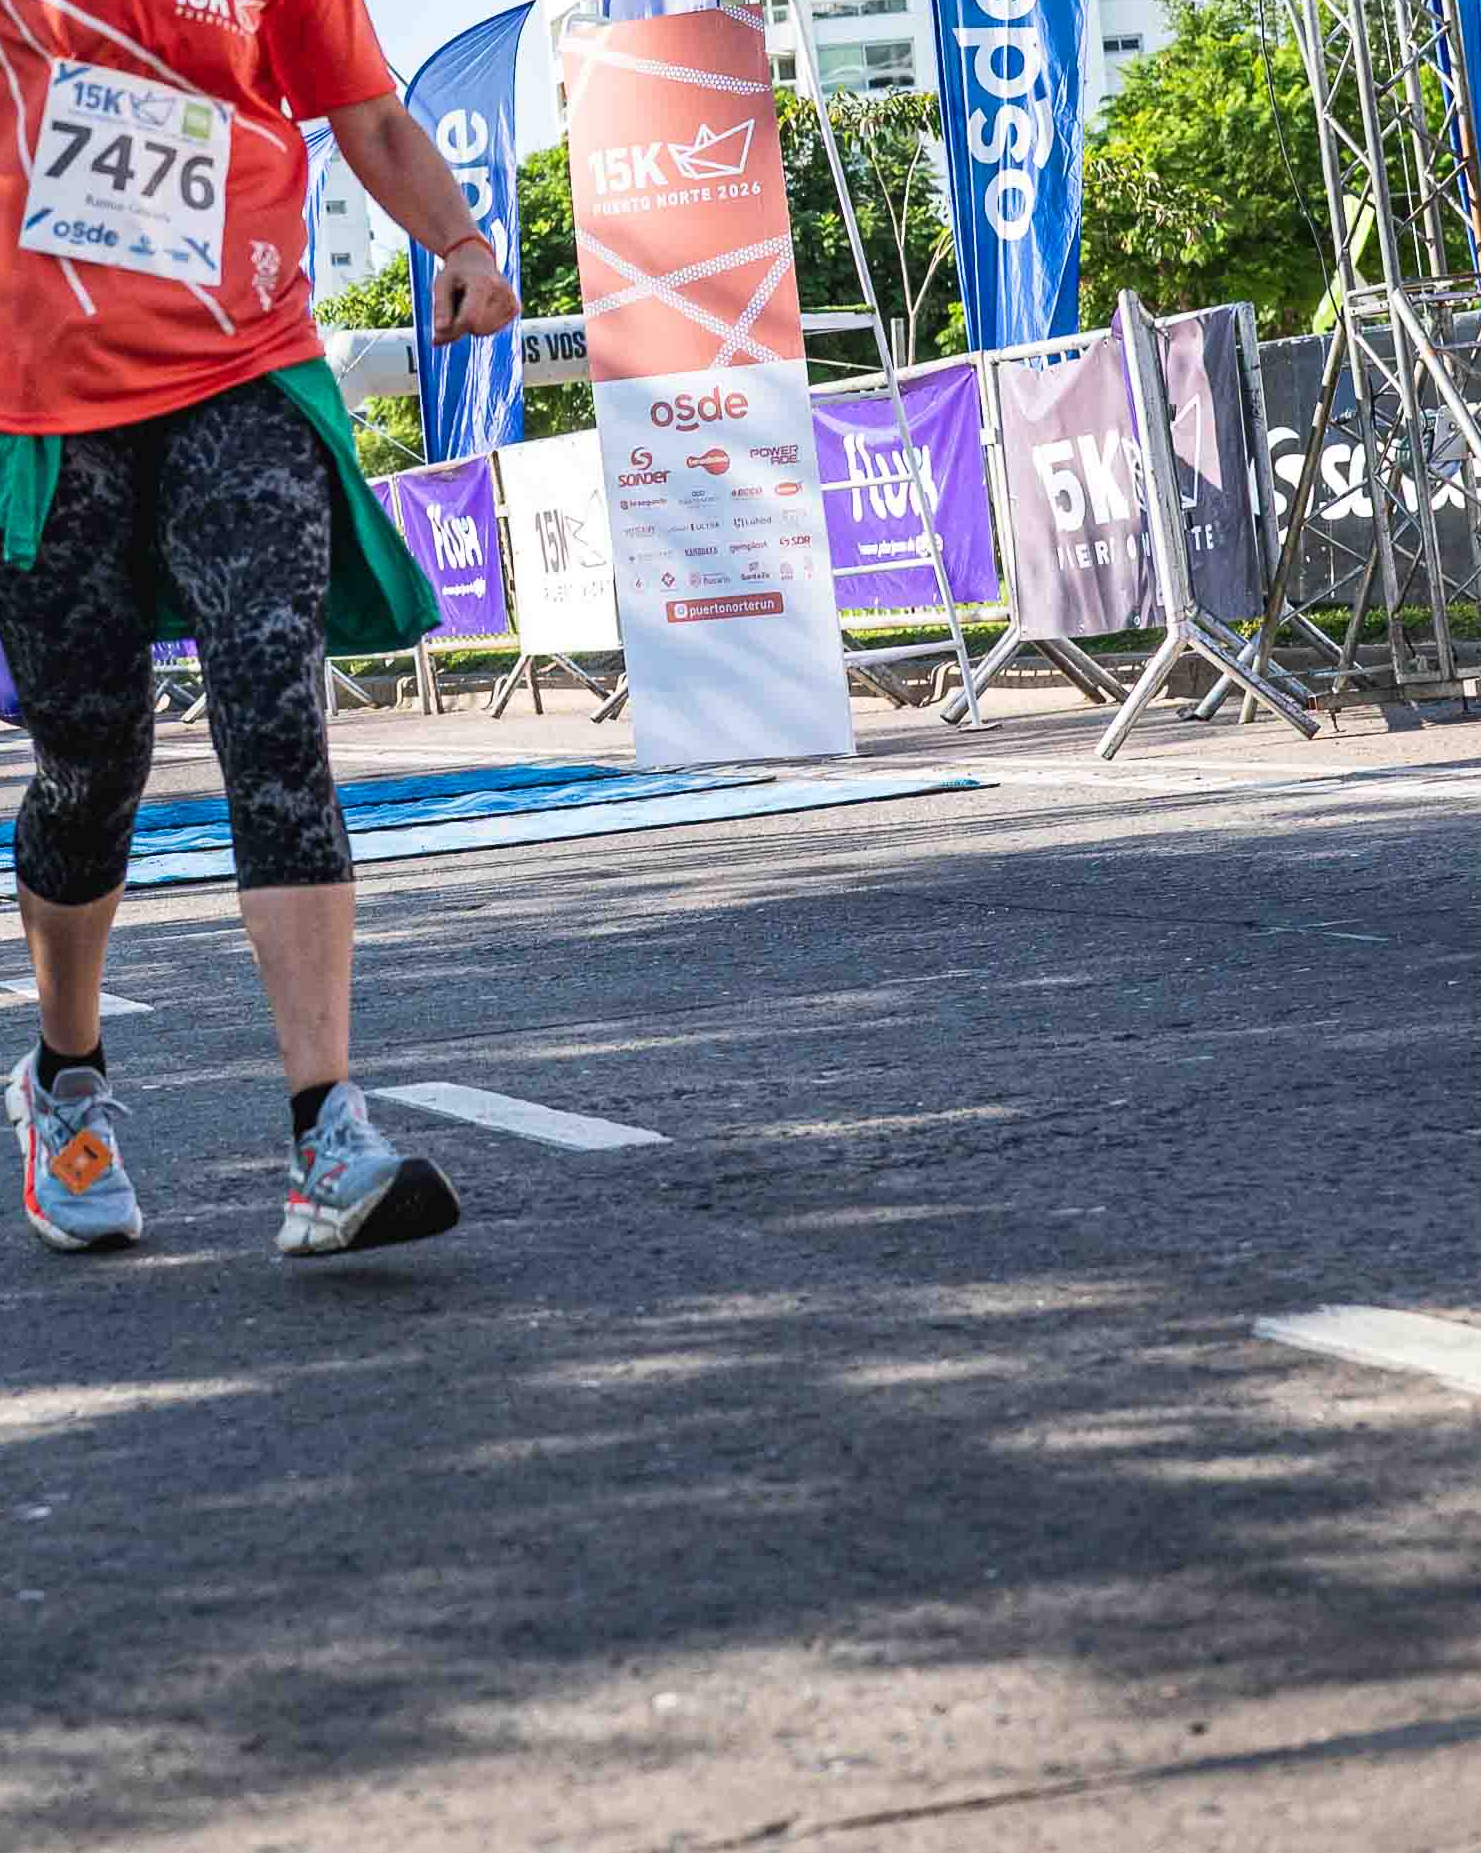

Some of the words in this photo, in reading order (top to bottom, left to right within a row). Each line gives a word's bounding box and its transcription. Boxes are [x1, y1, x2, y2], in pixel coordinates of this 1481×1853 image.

[72, 81, 123, 115] 15K
[44, 120, 216, 210] 7476
[588, 142, 668, 195] 15K
[656, 186, 713, 208] NORTE
[717, 181, 762, 200] 2026
[52, 219, 119, 248] osde
[650, 385, 749, 432] osde
[689, 599, 775, 618] puertonorterun
